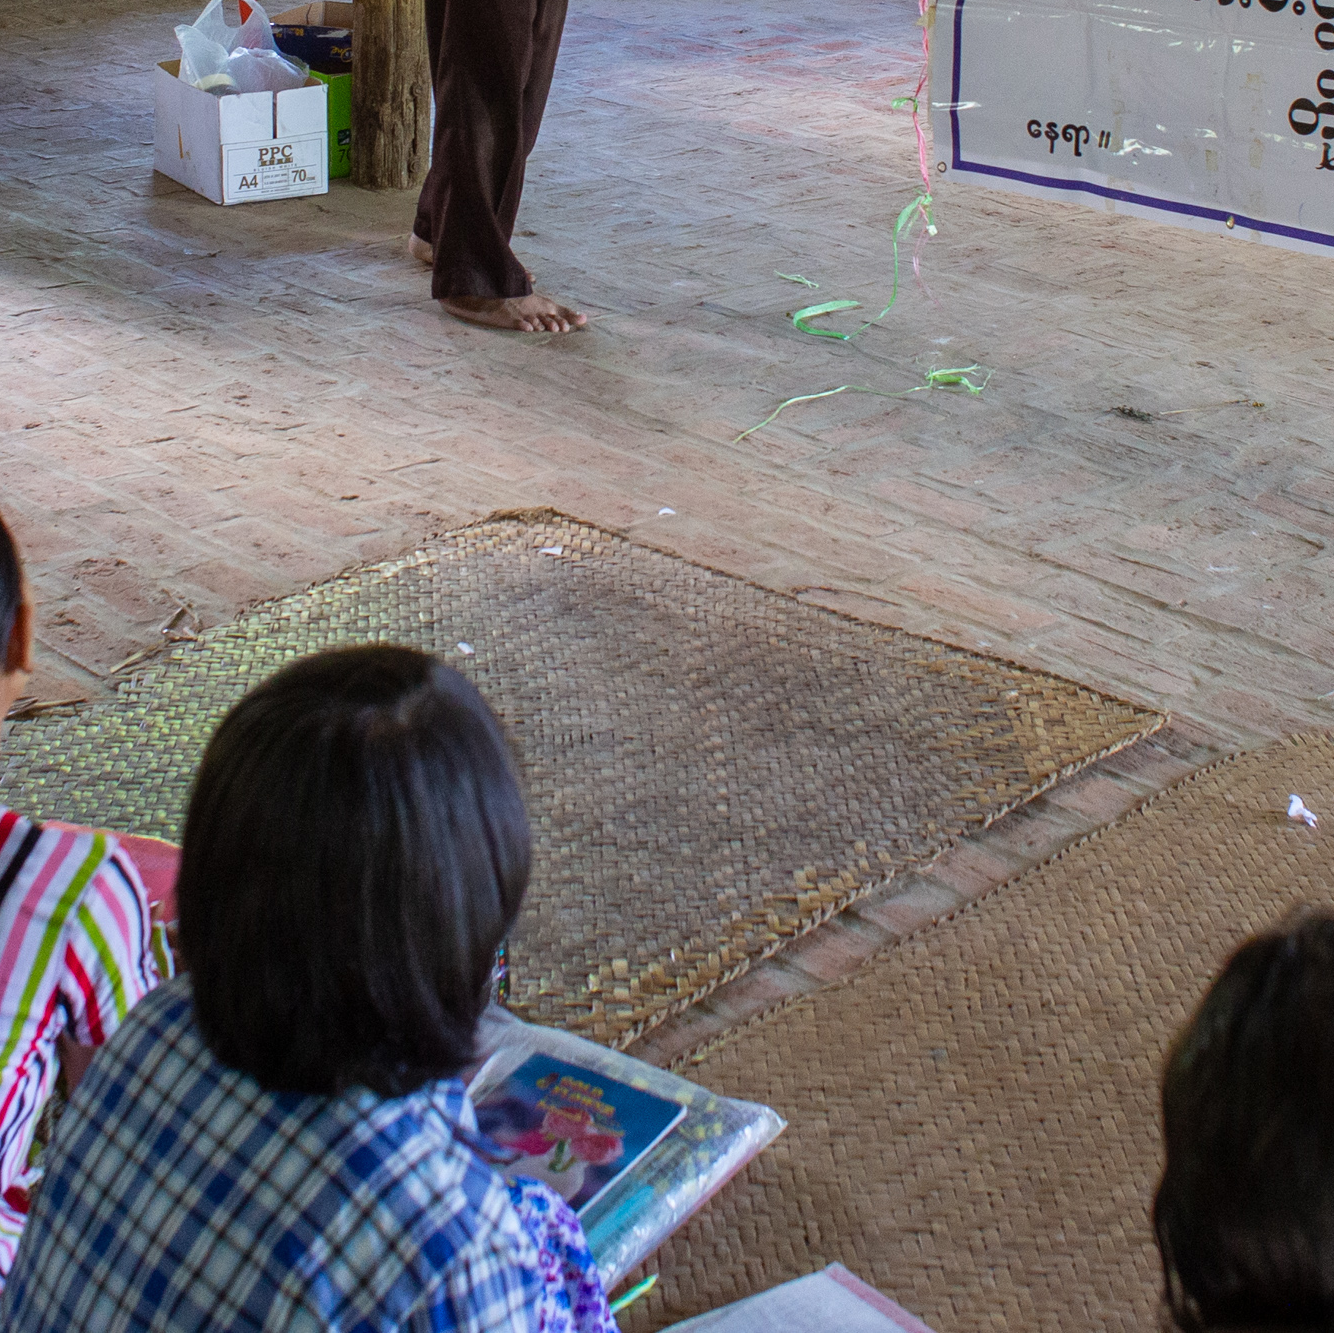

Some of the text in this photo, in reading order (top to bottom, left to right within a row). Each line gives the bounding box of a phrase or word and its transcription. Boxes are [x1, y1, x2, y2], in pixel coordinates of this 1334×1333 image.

[258, 144, 293, 161] PPC
[238, 174, 259, 190] A4
[291, 169, 307, 183] 70
